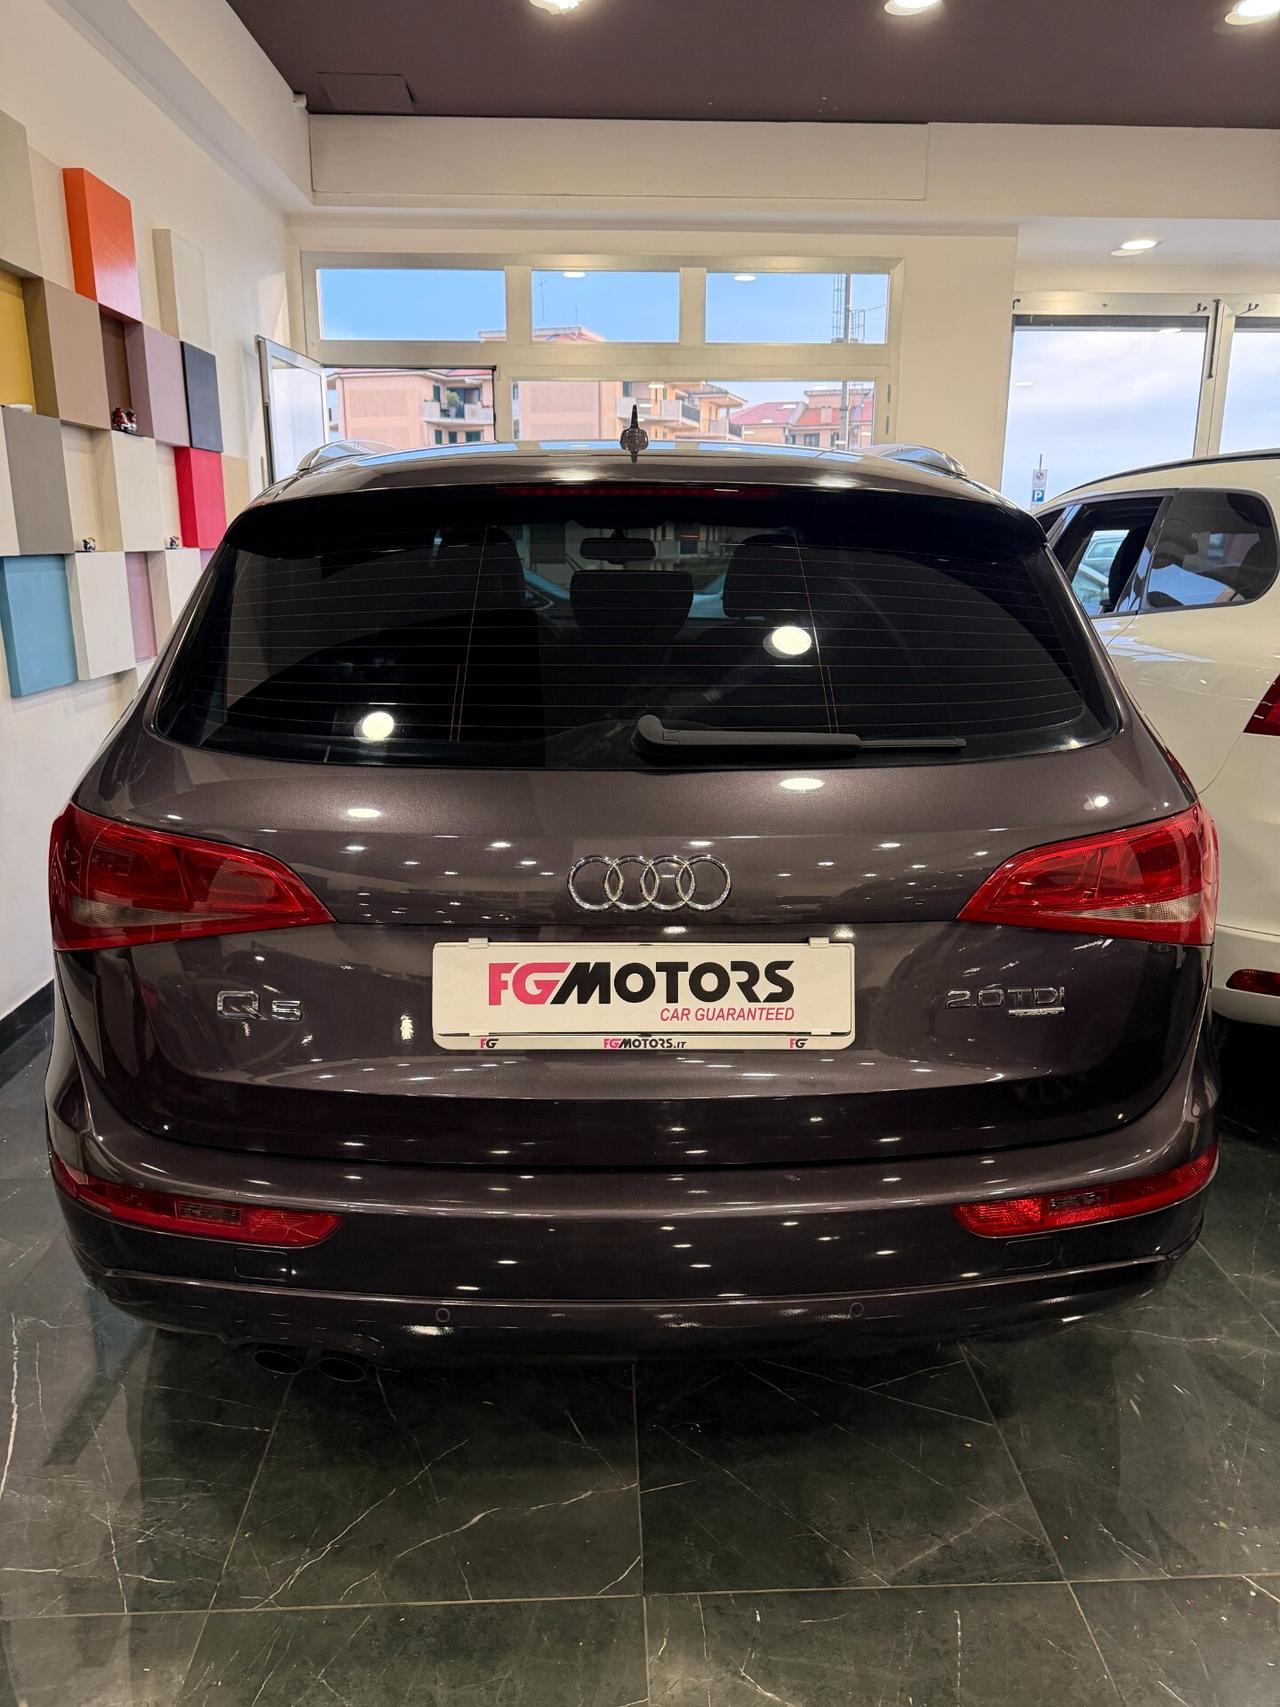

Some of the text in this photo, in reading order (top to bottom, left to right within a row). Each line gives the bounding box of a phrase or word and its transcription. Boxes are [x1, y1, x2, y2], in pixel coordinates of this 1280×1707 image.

[1034, 491, 1043, 501] P
[216, 990, 301, 1021] Q5
[660, 1007, 795, 1022] CAR GUARANTEED
[480, 1038, 499, 1049] FG
[789, 1038, 808, 1049] FG
